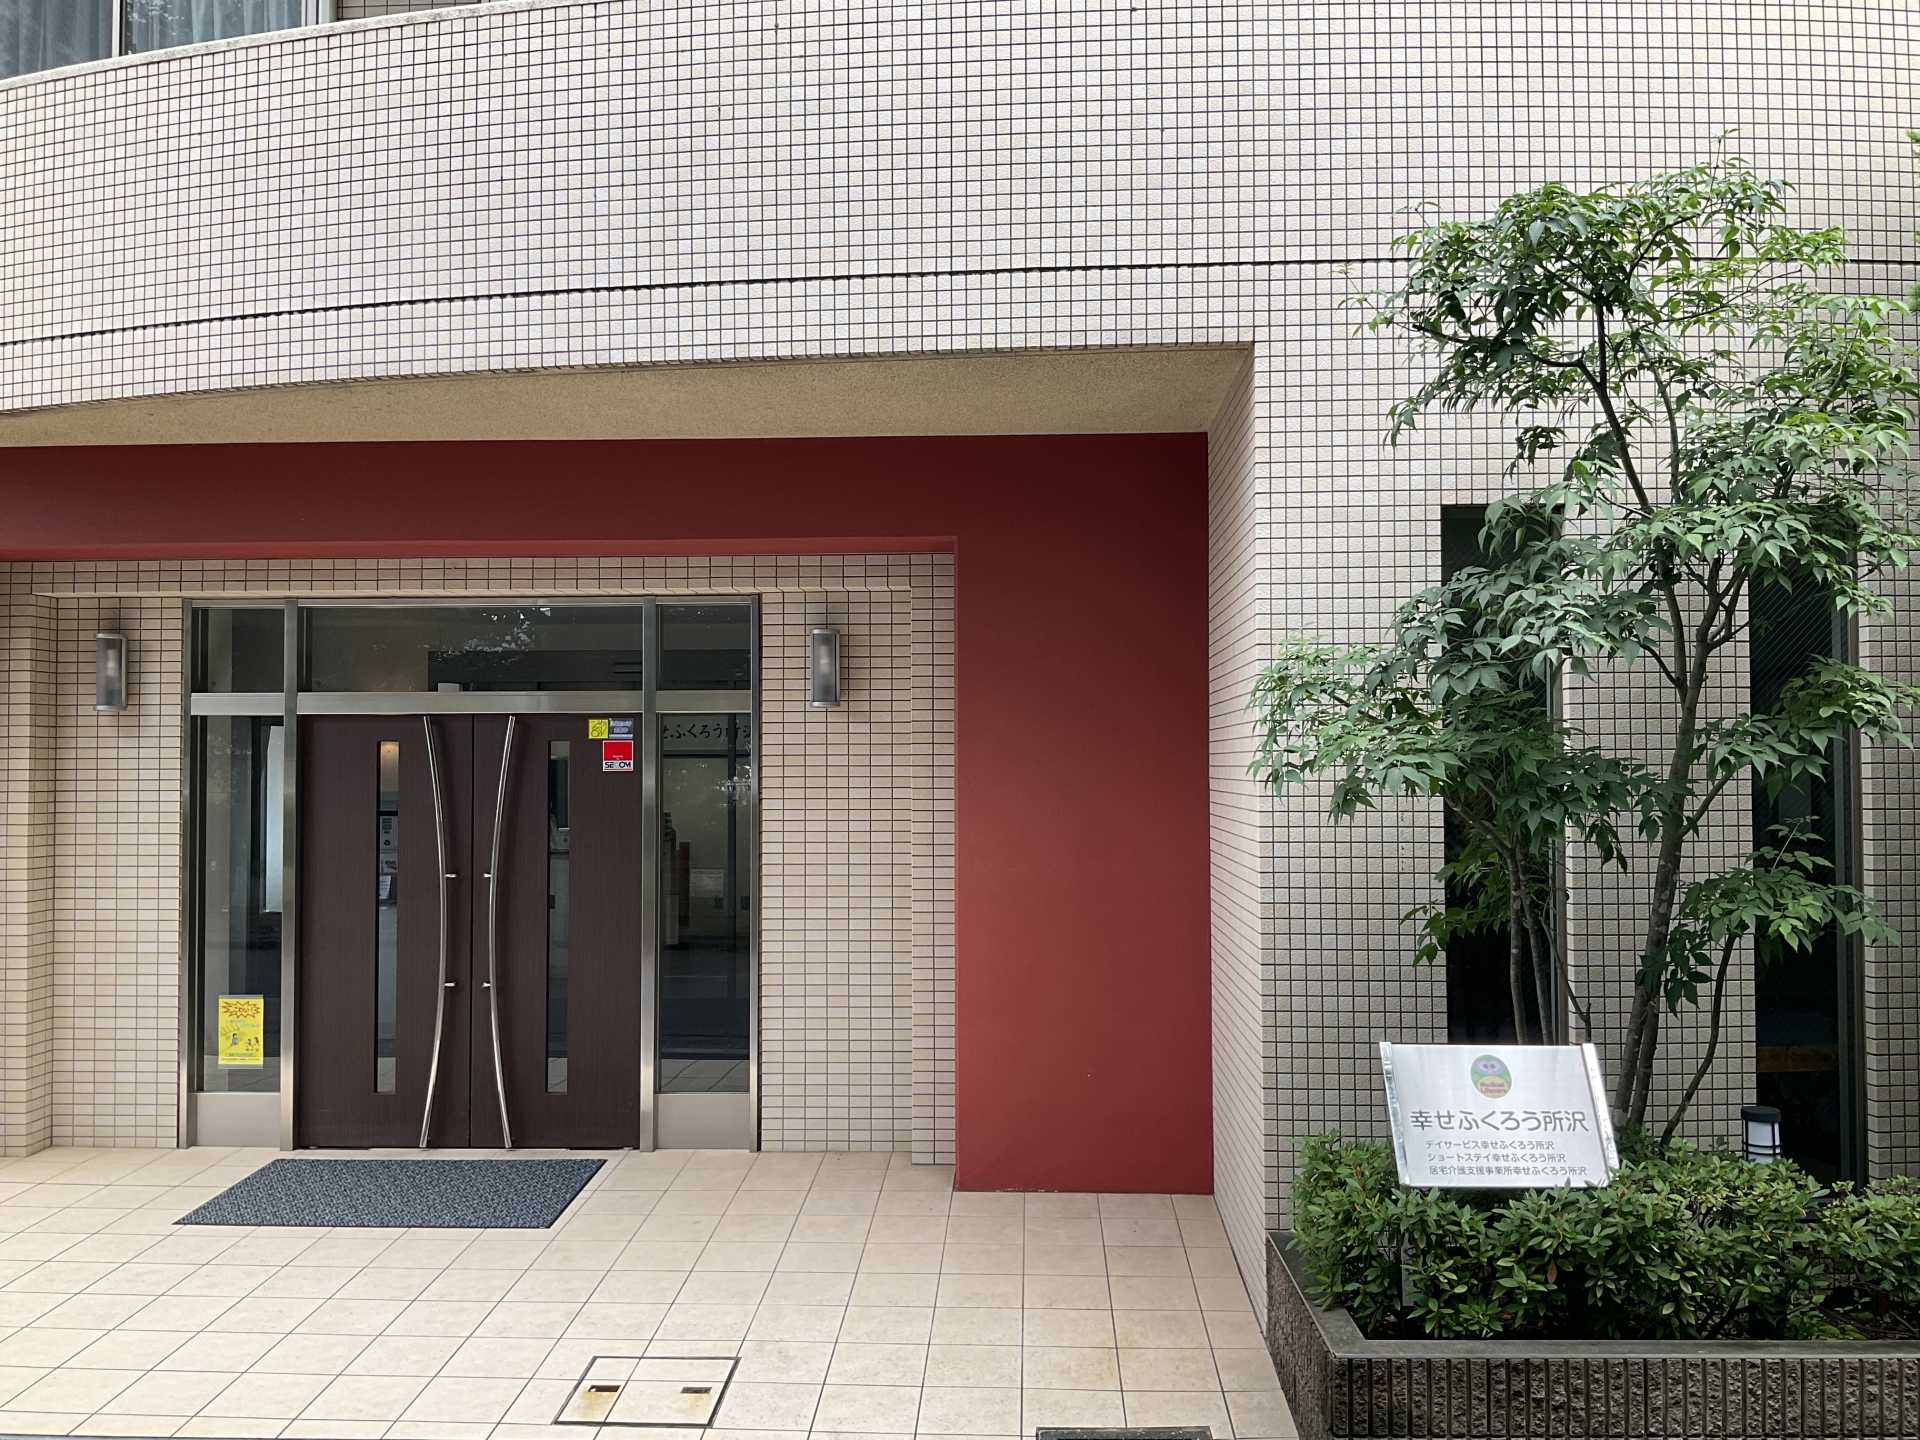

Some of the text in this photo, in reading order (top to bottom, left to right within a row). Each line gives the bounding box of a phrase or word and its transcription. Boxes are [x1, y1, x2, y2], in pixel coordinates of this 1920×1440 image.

[604, 761, 632, 769] SECOM
[1410, 1110, 1589, 1132] 幸せふくろう所沢
[1425, 1140, 1555, 1151] デイサービス幸せふくろう所沢
[1427, 1153, 1567, 1163] ショートステイ幸せふくろう所沢
[1429, 1166, 1588, 1176] 居宅介護支援事業所幸せふくろう所沢
